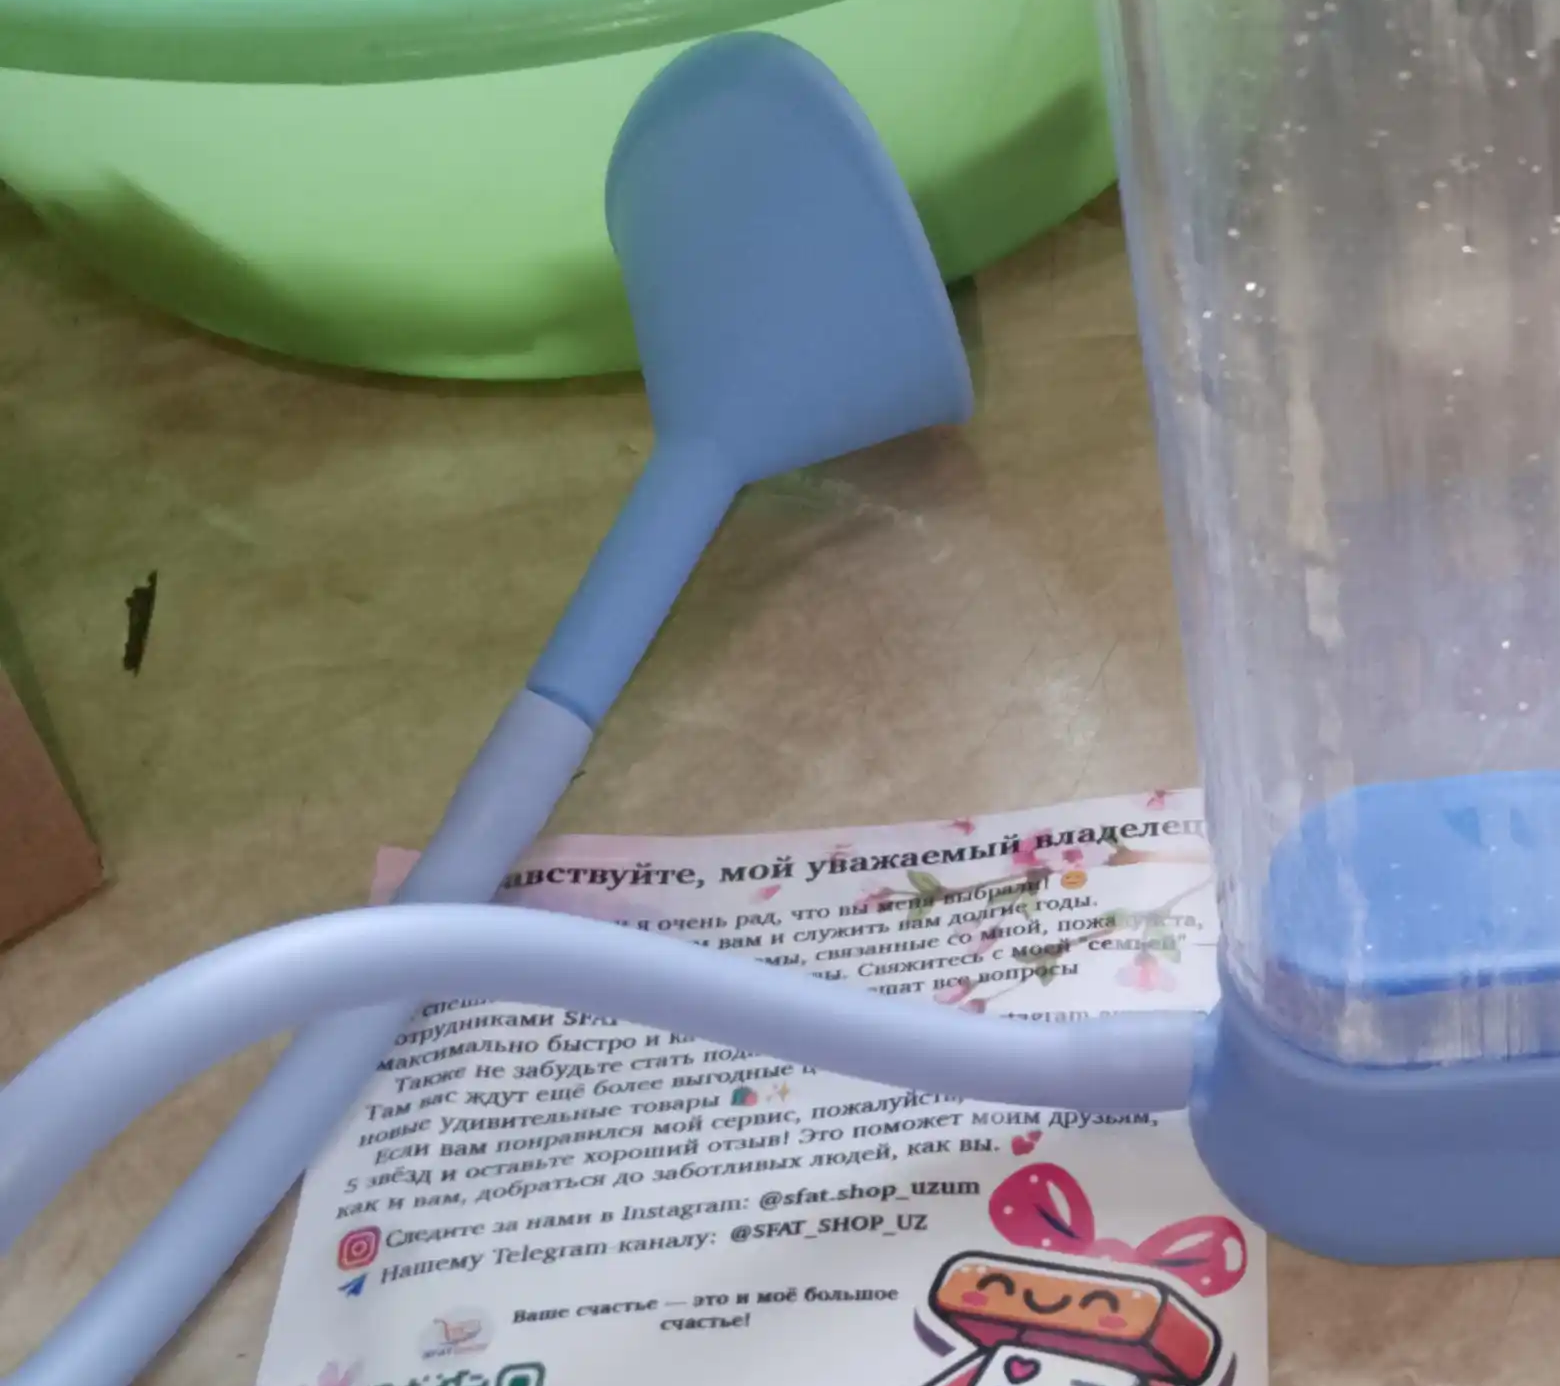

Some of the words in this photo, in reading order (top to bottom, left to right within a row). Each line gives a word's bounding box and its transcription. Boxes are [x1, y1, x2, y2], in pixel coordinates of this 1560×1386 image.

[502, 862, 705, 891] авствуйте,
[719, 856, 794, 883] мой
[806, 834, 1021, 883] уважаемый
[658, 917, 728, 932] очень
[735, 911, 782, 930] рад,
[791, 907, 830, 921] что
[838, 903, 869, 917] вы
[878, 896, 935, 914] меня
[944, 876, 1049, 907] выбрали!
[718, 936, 761, 951] вам
[771, 933, 784, 946] и
[792, 923, 890, 945] служить
[899, 916, 940, 932] вам
[947, 902, 1028, 927] долгие
[1036, 894, 1098, 912] годы.
[815, 937, 940, 962] связанные
[947, 932, 972, 947] со
[980, 920, 1047, 942] мной,
[858, 951, 984, 978] Свяжитесь
[993, 947, 1004, 961] с
[933, 974, 971, 992] все
[979, 962, 1079, 986] вопросы
[377, 1037, 539, 1073] максимально
[547, 1035, 637, 1055] быстро
[645, 1034, 659, 1047] и
[395, 1012, 553, 1046] отрудниками
[365, 1102, 411, 1122] Там
[419, 1090, 458, 1109] вас
[464, 1089, 529, 1108] ждут
[536, 1083, 586, 1102] ещё
[593, 1077, 664, 1096] более
[671, 1063, 794, 1089] выгодные
[395, 1065, 466, 1093] Также
[475, 1064, 505, 1079] не
[513, 1060, 623, 1081] забудьте
[630, 1053, 695, 1070] стать
[358, 1115, 431, 1148] новые
[438, 1103, 622, 1134] удивительные
[630, 1094, 720, 1115] товары
[375, 1142, 430, 1165] Если
[439, 1139, 487, 1157] вам
[496, 1123, 644, 1154] понравился
[652, 1114, 704, 1135] мой
[711, 1109, 801, 1132] сервис,
[335, 1198, 379, 1221] как
[388, 1196, 404, 1211] и
[413, 1192, 467, 1211] вам,
[475, 1171, 605, 1203] добраться
[613, 1172, 644, 1189] до
[652, 1156, 802, 1183] заботливых
[809, 1143, 897, 1168] людей,
[907, 1138, 950, 1157] как
[959, 1139, 1000, 1154] вы.
[344, 1178, 358, 1194] 5
[366, 1165, 432, 1189] звёзд
[440, 1168, 456, 1182] и
[465, 1155, 575, 1180] оставьте
[583, 1138, 698, 1166] хороший
[708, 1130, 789, 1153] отзыв!
[798, 1127, 843, 1145] Это
[852, 1113, 964, 1138] поможет
[972, 1111, 1040, 1126] моим
[385, 1220, 485, 1249] Следите
[492, 1219, 519, 1234] за
[525, 1213, 592, 1230] нами
[600, 1210, 613, 1223] в
[621, 1197, 749, 1226] Instagram:
[759, 1178, 981, 1212] @sfat.shop_uzum
[381, 1251, 484, 1285] Нашему
[730, 1214, 928, 1243] @SFAT_SHOP_UZ
[512, 1307, 570, 1325] Ваше
[576, 1297, 659, 1318] счастье
[693, 1292, 729, 1308] это
[737, 1293, 750, 1306] и
[756, 1286, 797, 1304] моё
[804, 1286, 899, 1304] большое
[660, 1313, 751, 1332] счастье!
